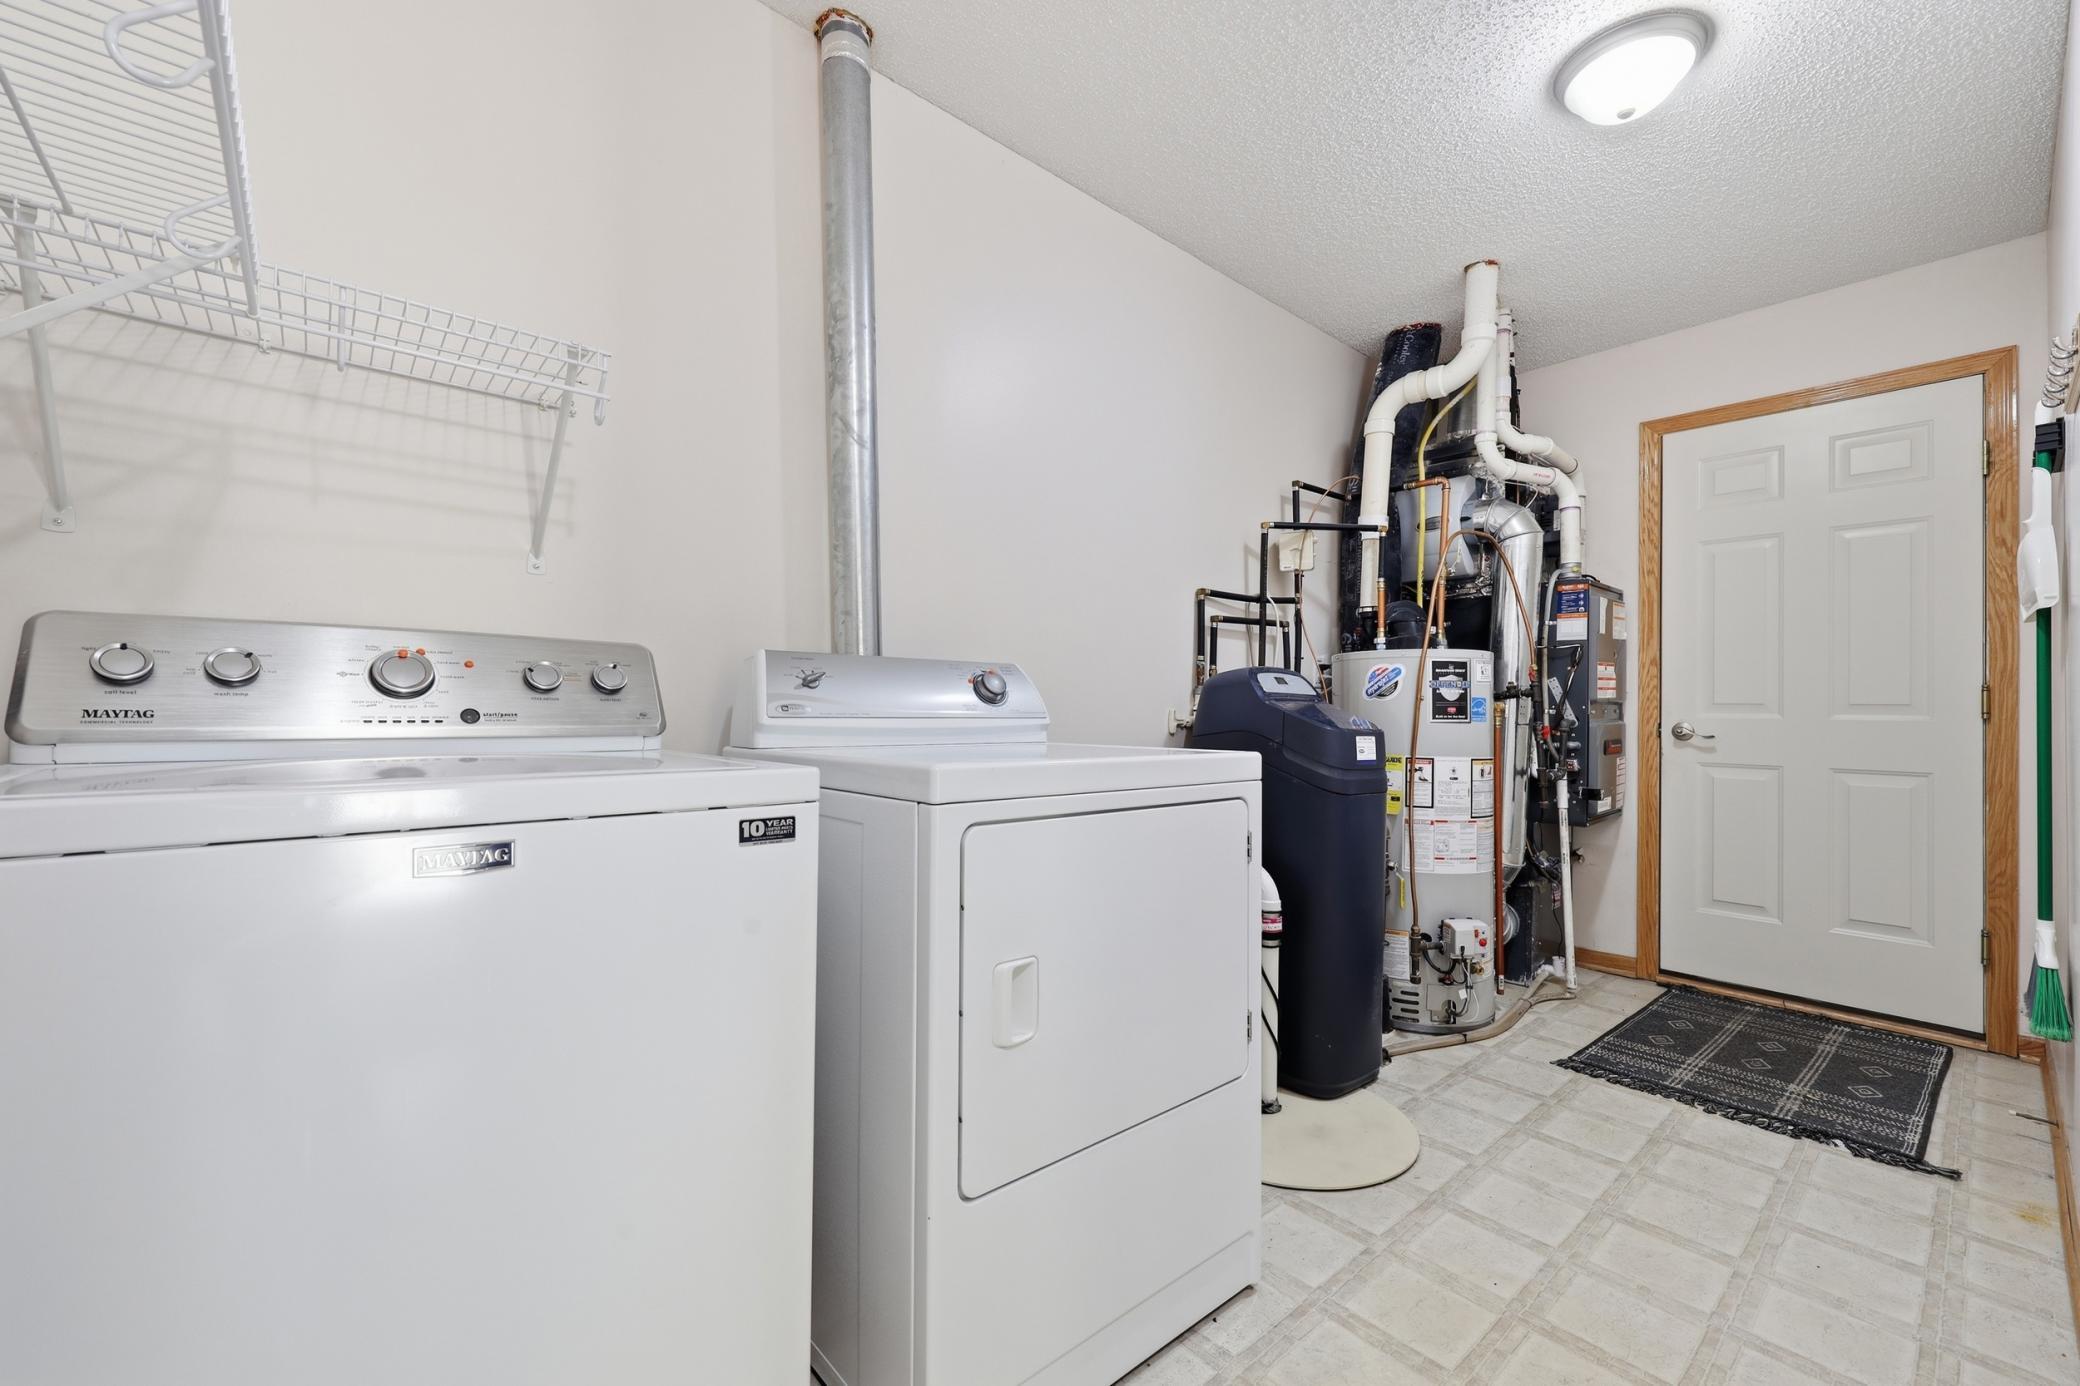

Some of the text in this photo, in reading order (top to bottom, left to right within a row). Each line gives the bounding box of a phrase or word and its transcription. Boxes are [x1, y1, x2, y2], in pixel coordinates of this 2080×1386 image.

[81, 708, 155, 719] MAYTAG
[741, 818, 794, 838] 10 YEAR
[421, 847, 511, 871] MAYTAG
